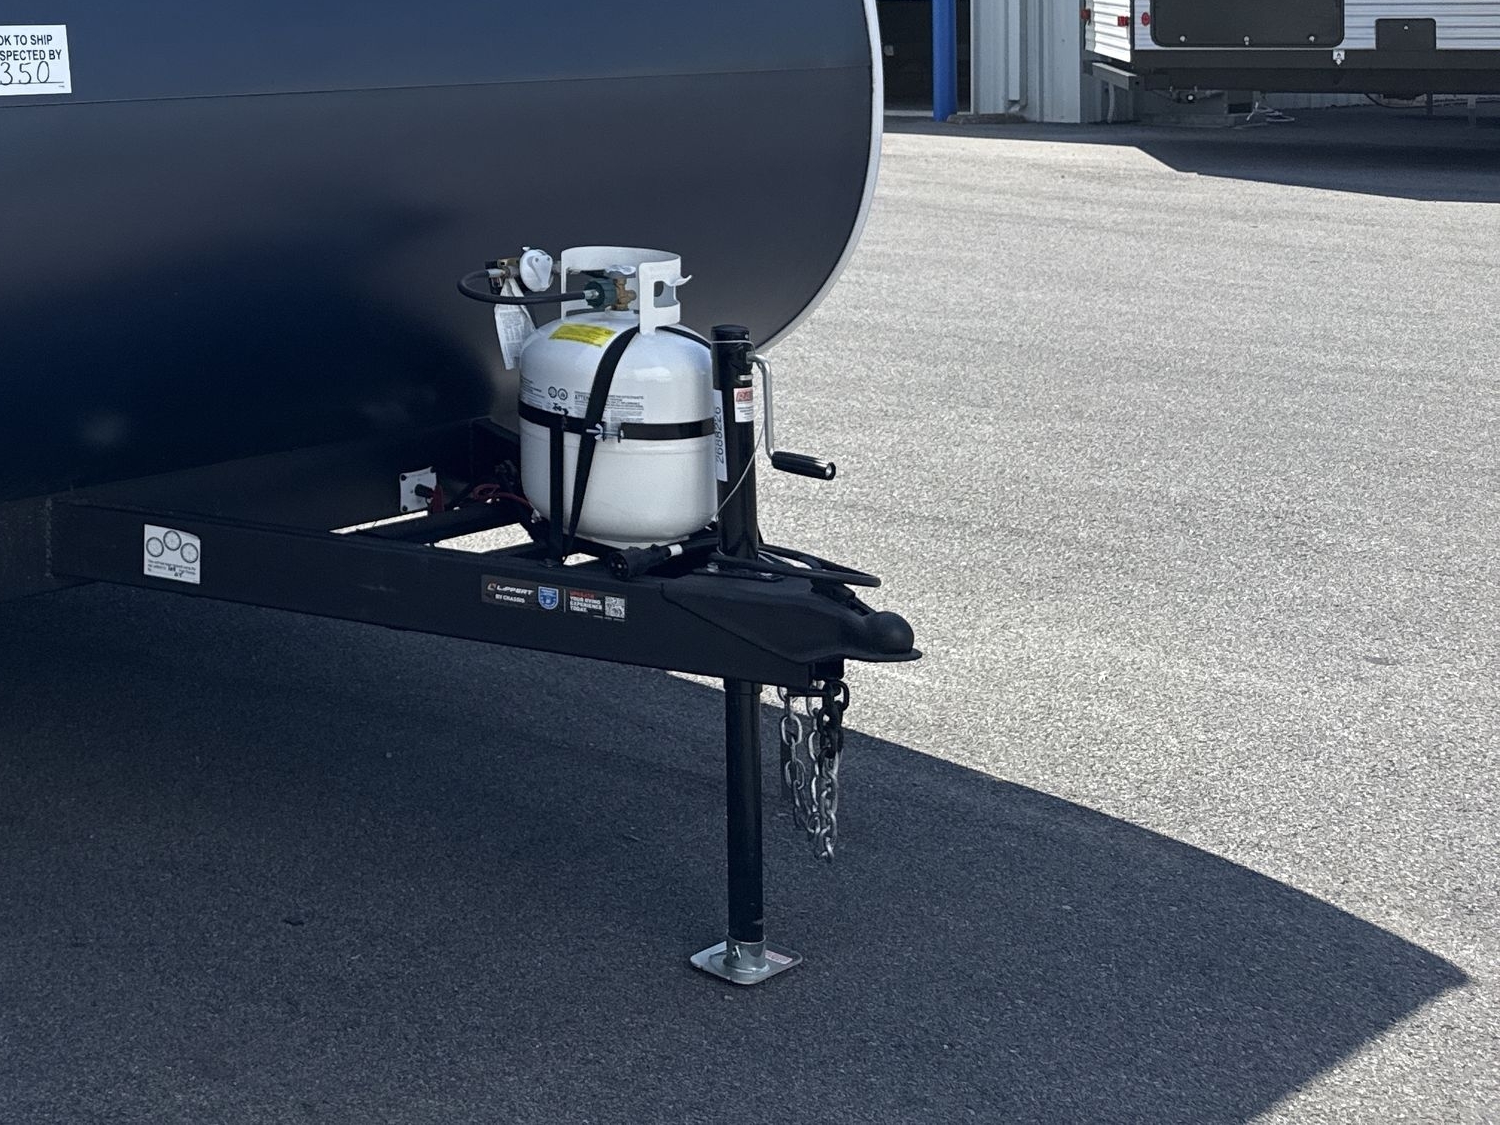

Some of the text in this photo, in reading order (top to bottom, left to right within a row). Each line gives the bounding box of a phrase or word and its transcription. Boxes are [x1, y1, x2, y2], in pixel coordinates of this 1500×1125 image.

[14, 34, 28, 46] TO
[30, 34, 53, 46] SHIP
[48, 49, 62, 61] BY
[0, 60, 50, 86] 350
